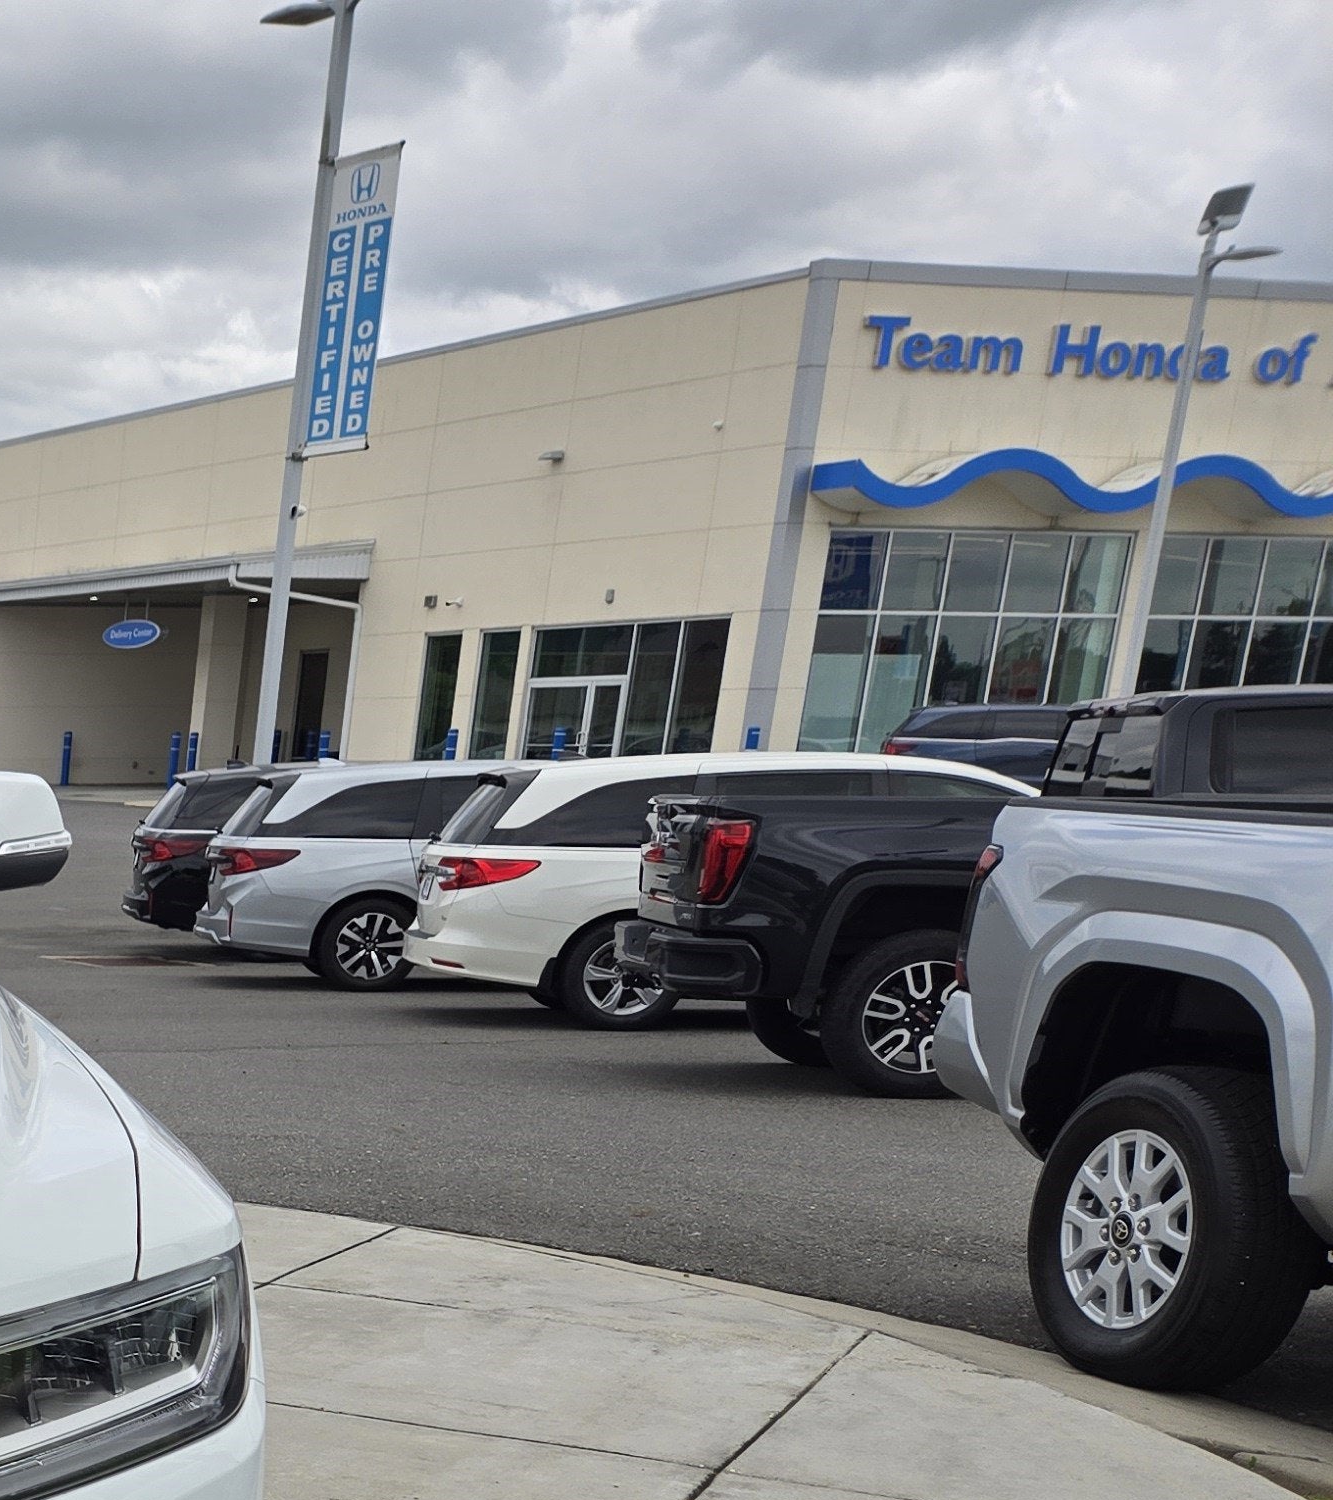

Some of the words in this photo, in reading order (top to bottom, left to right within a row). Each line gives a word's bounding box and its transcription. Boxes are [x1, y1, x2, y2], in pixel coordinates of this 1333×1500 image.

[336, 203, 387, 224] HONDA
[363, 225, 384, 293] PRE
[311, 231, 352, 438] CERTIFIED
[865, 314, 1024, 375] Team
[1253, 332, 1320, 385] of
[345, 319, 375, 434] OWNED
